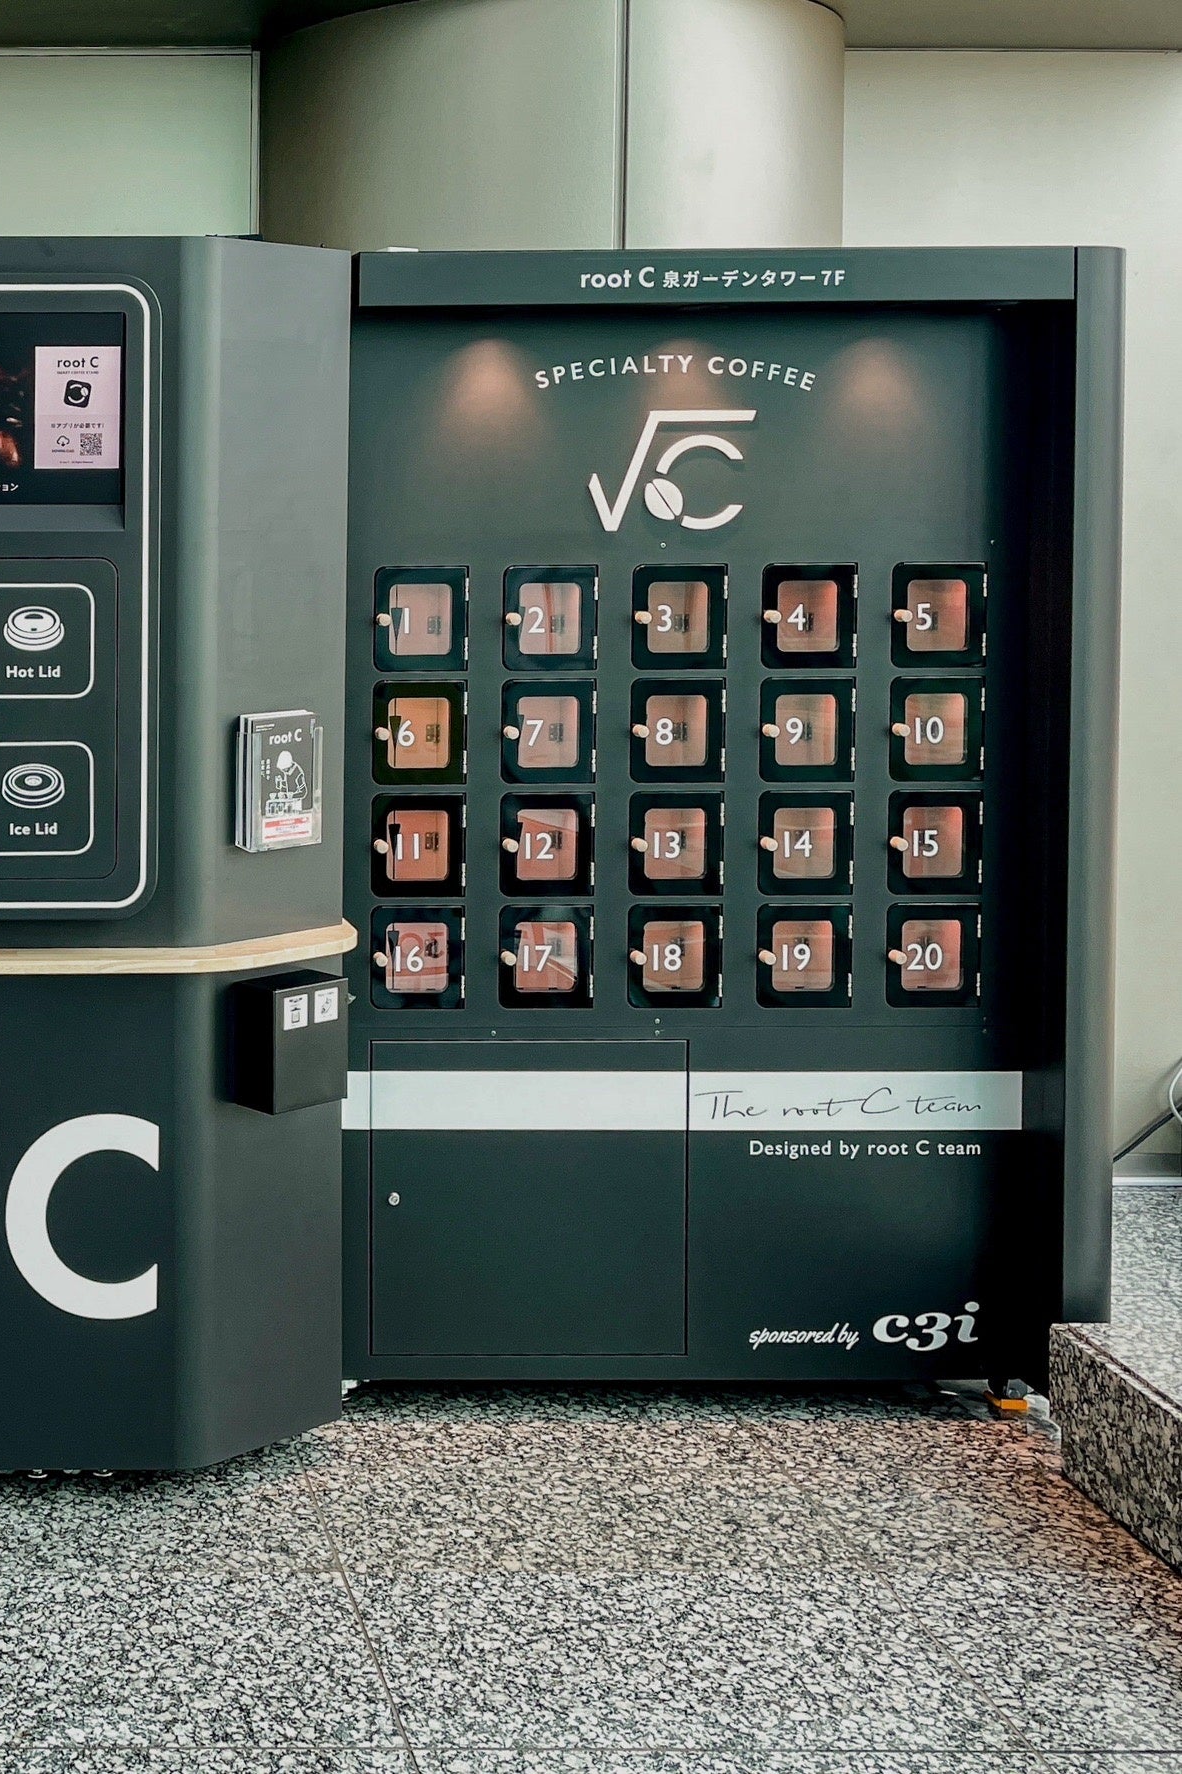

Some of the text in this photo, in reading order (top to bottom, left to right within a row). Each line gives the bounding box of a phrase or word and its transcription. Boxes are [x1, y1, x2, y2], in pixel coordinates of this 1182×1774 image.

[580, 267, 846, 288] root C 泉ガーデンタワー 7F
[57, 356, 99, 368] root C
[534, 355, 816, 392] SPECIALTY COFFEE
[402, 607, 410, 634] 1
[528, 606, 546, 634] 2
[656, 604, 673, 632] 3
[787, 604, 806, 632] 4
[915, 603, 932, 631] 5
[6, 665, 61, 678] Hot Lid
[269, 729, 302, 745] root C
[397, 719, 416, 748] 6
[526, 719, 544, 747] 7
[655, 718, 674, 746] 8
[785, 717, 804, 745] 9
[914, 716, 944, 744] 10
[9, 823, 58, 835] Ice Lid
[396, 833, 420, 860] 11
[524, 832, 554, 860] 12
[652, 831, 682, 860] 13
[784, 830, 813, 858] 14
[912, 830, 940, 858] 15
[395, 945, 424, 973] 16
[522, 945, 553, 972] 17
[652, 944, 684, 972] 18
[782, 944, 812, 972] 19
[906, 943, 943, 971] 20
[694, 1087, 981, 1120] The root C team
[749, 1140, 981, 1160] Designed by root C team
[6, 1114, 160, 1320] C
[748, 1301, 980, 1350] sponsored by c3i
